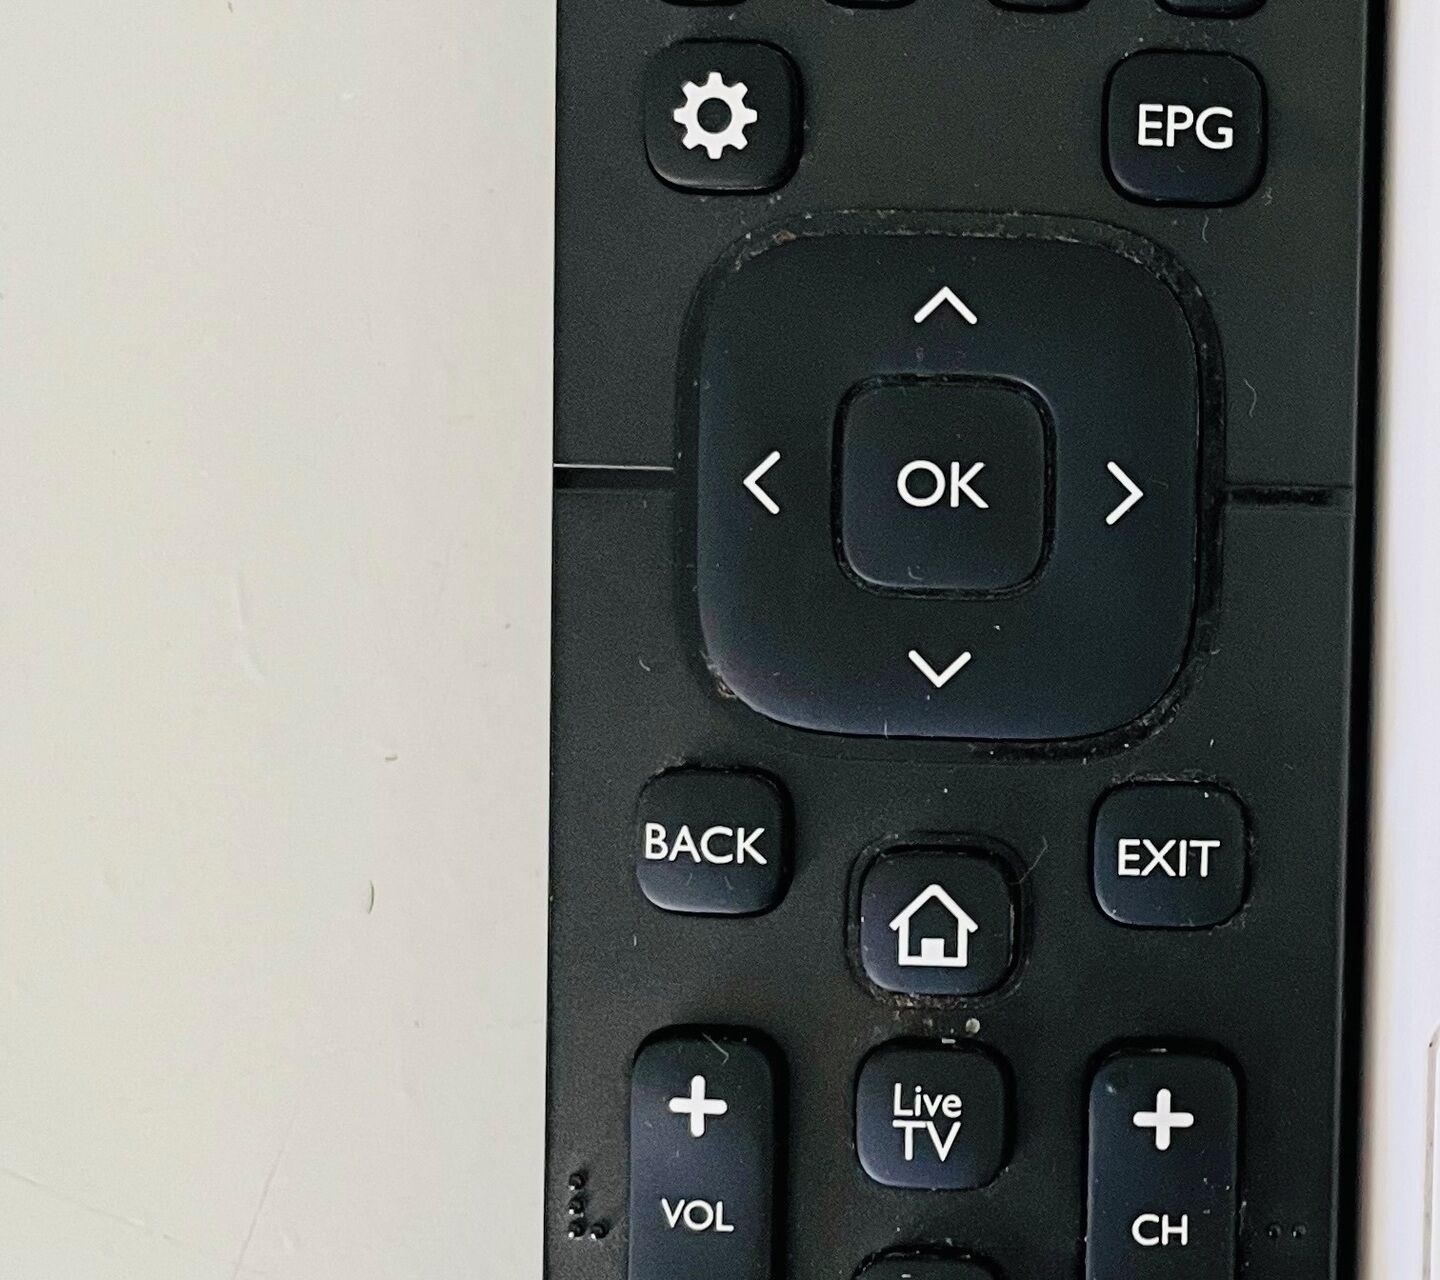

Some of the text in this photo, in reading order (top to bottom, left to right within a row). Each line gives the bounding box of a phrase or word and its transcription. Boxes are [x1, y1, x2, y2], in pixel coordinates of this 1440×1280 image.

[1138, 104, 1233, 149] EPG
[898, 460, 988, 508] OK
[645, 823, 767, 864] BACK
[1118, 839, 1220, 877] EXIT
[893, 1084, 963, 1120] Live
[892, 1121, 961, 1162] TV
[662, 1198, 734, 1231] VOL
[1132, 1214, 1187, 1245] CH
